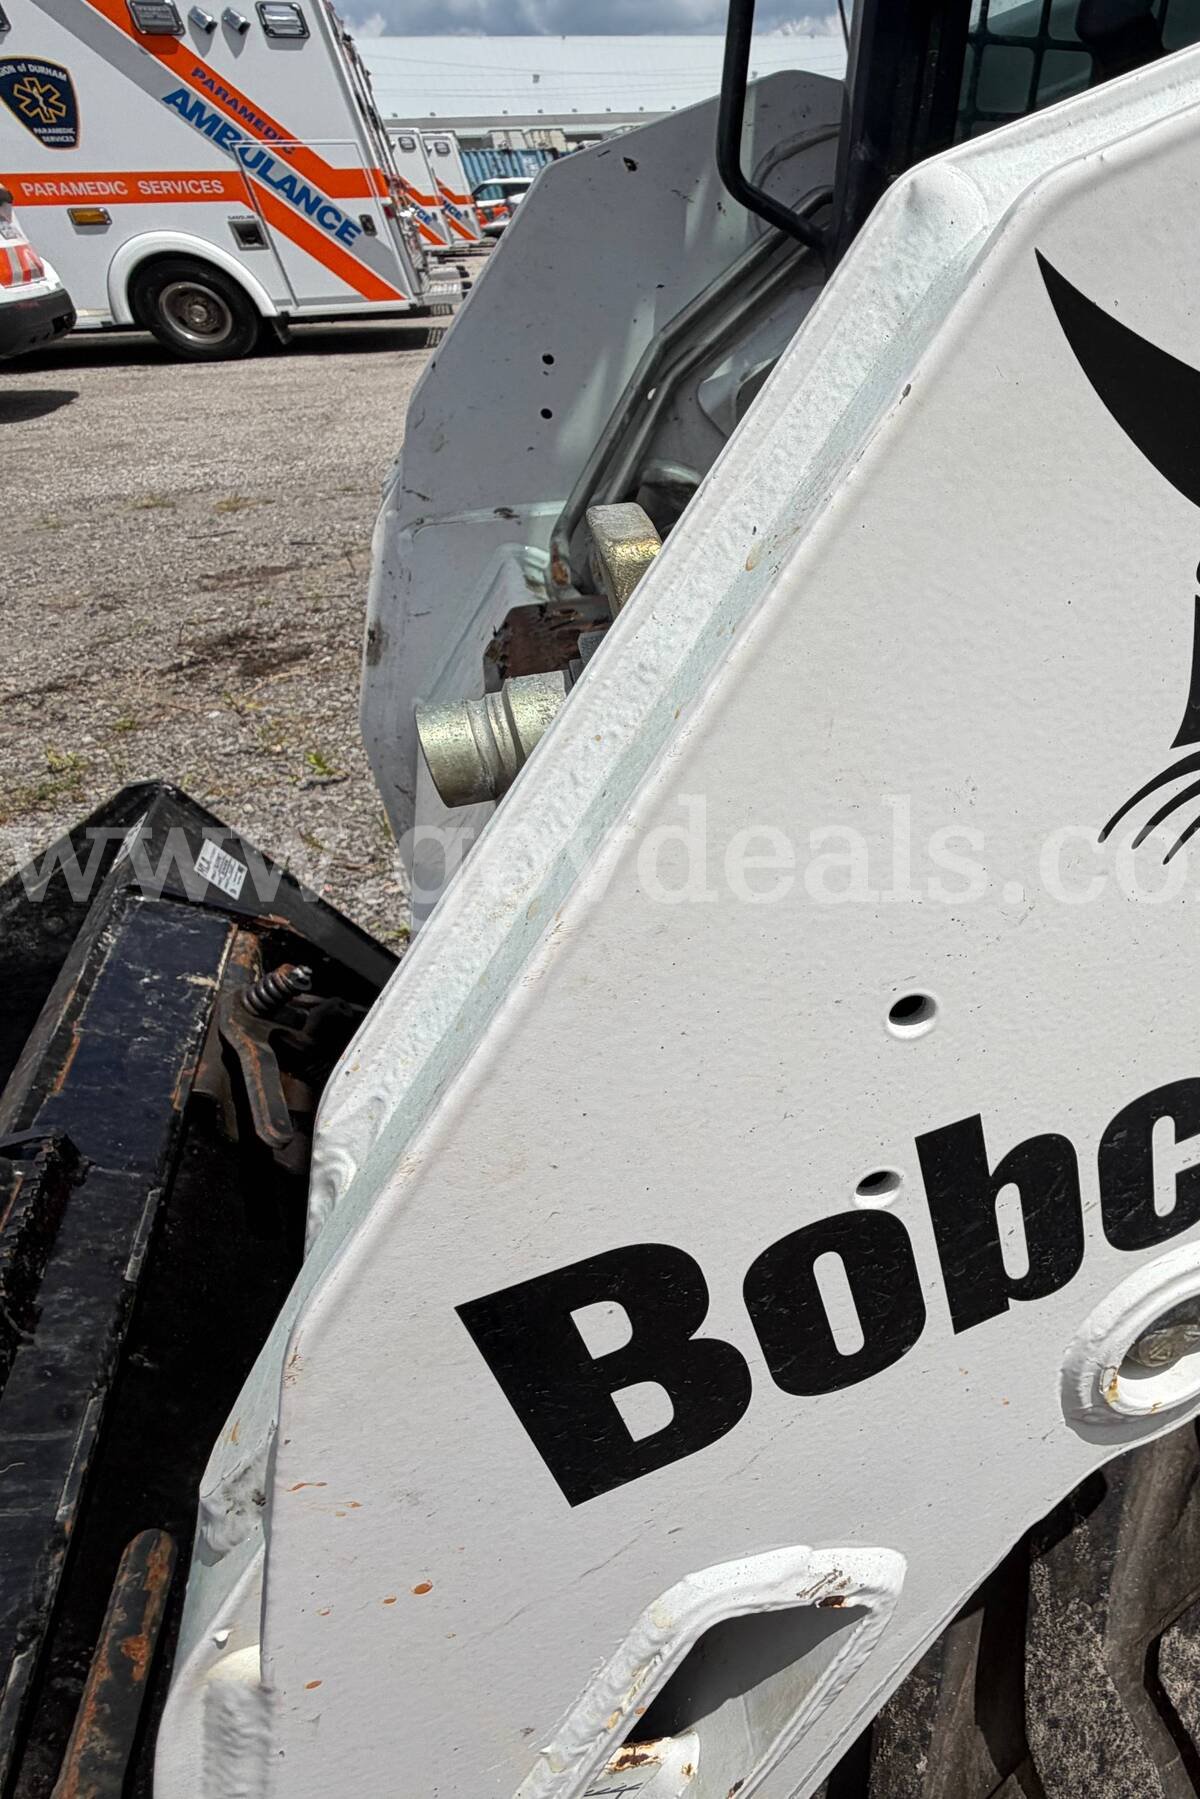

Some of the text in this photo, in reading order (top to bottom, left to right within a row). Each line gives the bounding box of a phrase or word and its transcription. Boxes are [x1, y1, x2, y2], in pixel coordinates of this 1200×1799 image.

[28, 64, 67, 81] DURHAM
[191, 67, 296, 154] PARAMEDIC
[21, 180, 225, 197] PARAMEDIC SERVICES
[161, 87, 363, 247] AMBULANCE
